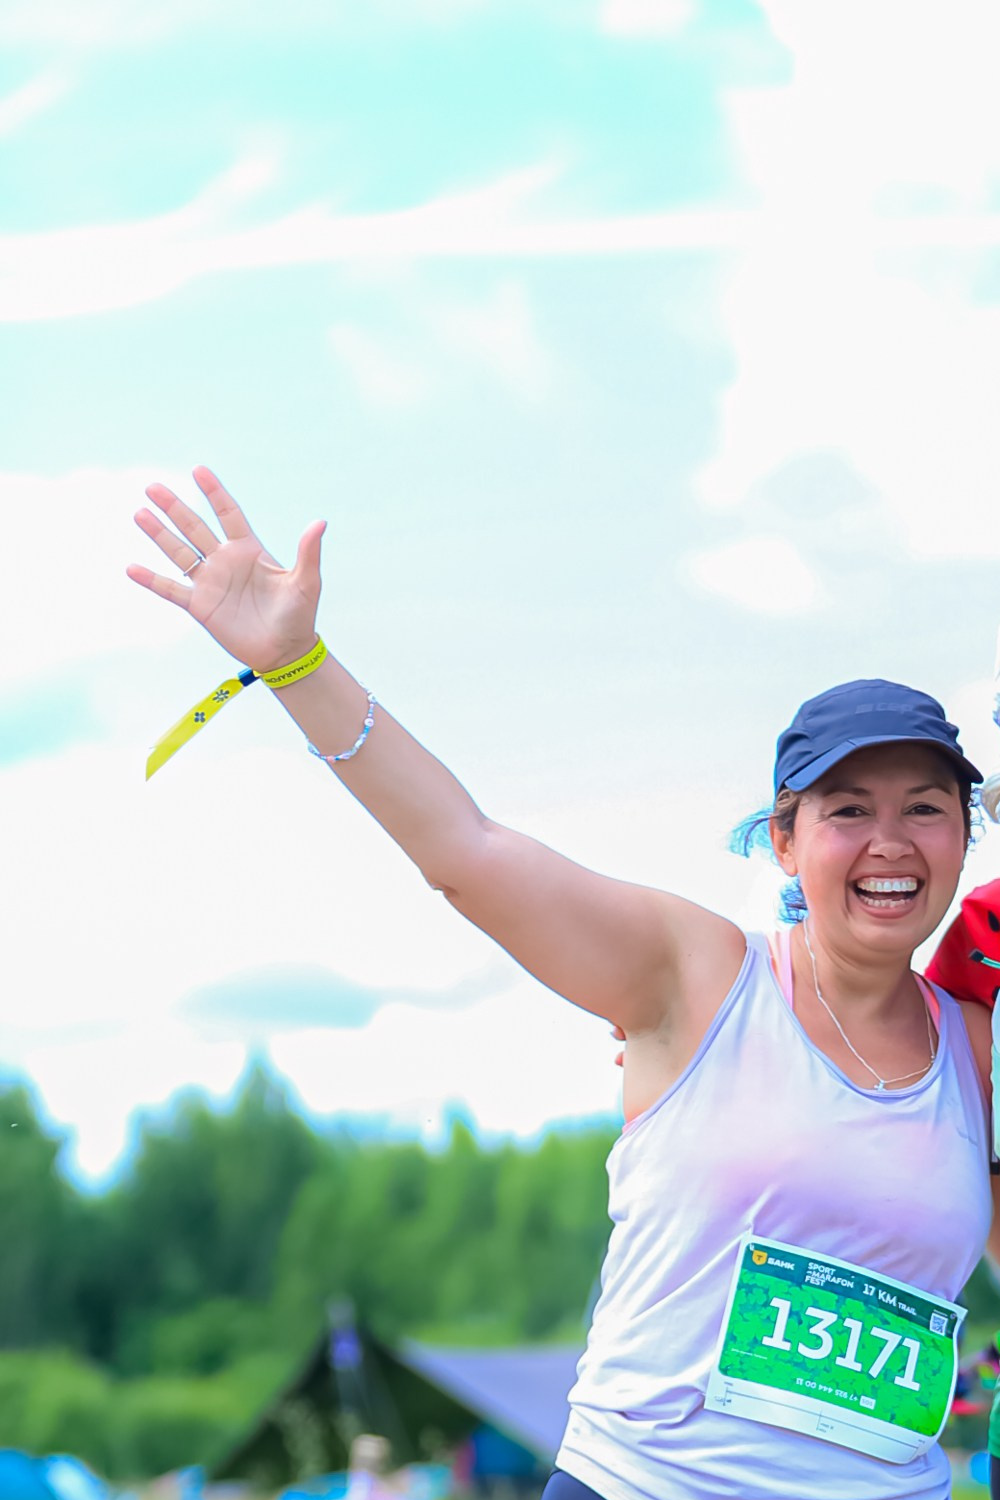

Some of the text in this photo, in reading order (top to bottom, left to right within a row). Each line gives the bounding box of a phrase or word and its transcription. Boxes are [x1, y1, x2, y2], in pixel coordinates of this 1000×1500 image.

[808, 1262, 836, 1275] SPORT
[805, 1275, 826, 1287] FEST
[862, 1283, 876, 1297] 17
[878, 1289, 897, 1307] KM
[898, 1302, 917, 1316] TRAIL
[762, 1297, 921, 1392] 13171
